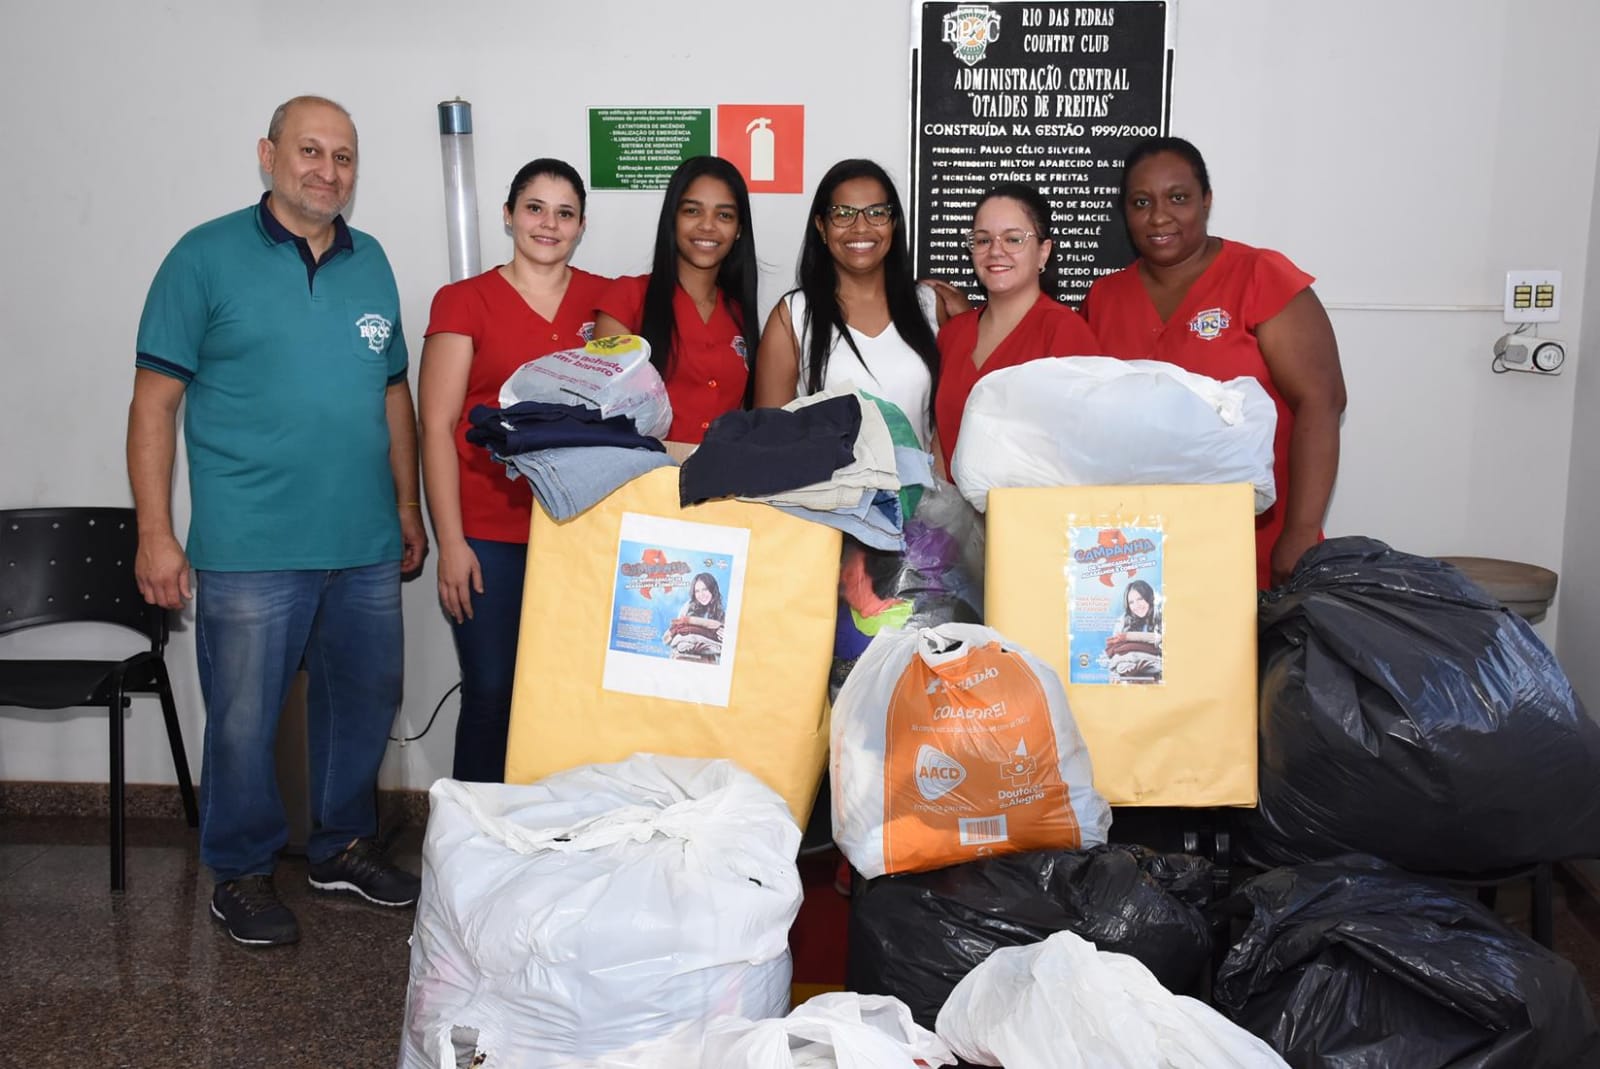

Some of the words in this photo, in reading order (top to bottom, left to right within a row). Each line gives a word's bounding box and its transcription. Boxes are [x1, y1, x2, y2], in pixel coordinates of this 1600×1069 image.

[1022, 8, 1042, 26] RIO
[1049, 8, 1069, 26] DAS
[1075, 8, 1115, 26] PEDRAS
[1024, 35, 1074, 52] COUNTRY
[1081, 35, 1110, 52] CLUB
[954, 65, 1061, 94] ADMINISTRAÇÃO
[1069, 69, 1130, 91] CENTRAL
[1034, 95, 1049, 117] DE
[924, 122, 1007, 136] CONSTRUÍDA
[1012, 125, 1031, 136] NA
[1035, 123, 1084, 136] GESTÃO
[1091, 125, 1158, 137] 1999/2000
[980, 146, 1013, 154] PAULO
[1016, 144, 1045, 154] CÉLIO
[1047, 146, 1091, 154] SILVEIRA
[1000, 160, 1035, 168] MILTON
[1039, 160, 1094, 168] APARECIDO
[1097, 160, 1109, 168] DA
[989, 171, 1031, 182] OTAÍDES
[1035, 173, 1047, 181] DE
[1050, 173, 1089, 181] FREITAS
[1077, 214, 1112, 222] MACIEL
[1061, 225, 1102, 235] CHICALÉ
[1066, 254, 1095, 262] FILHO
[1074, 538, 1157, 564] CAMPANHA
[919, 766, 961, 780] AACD
